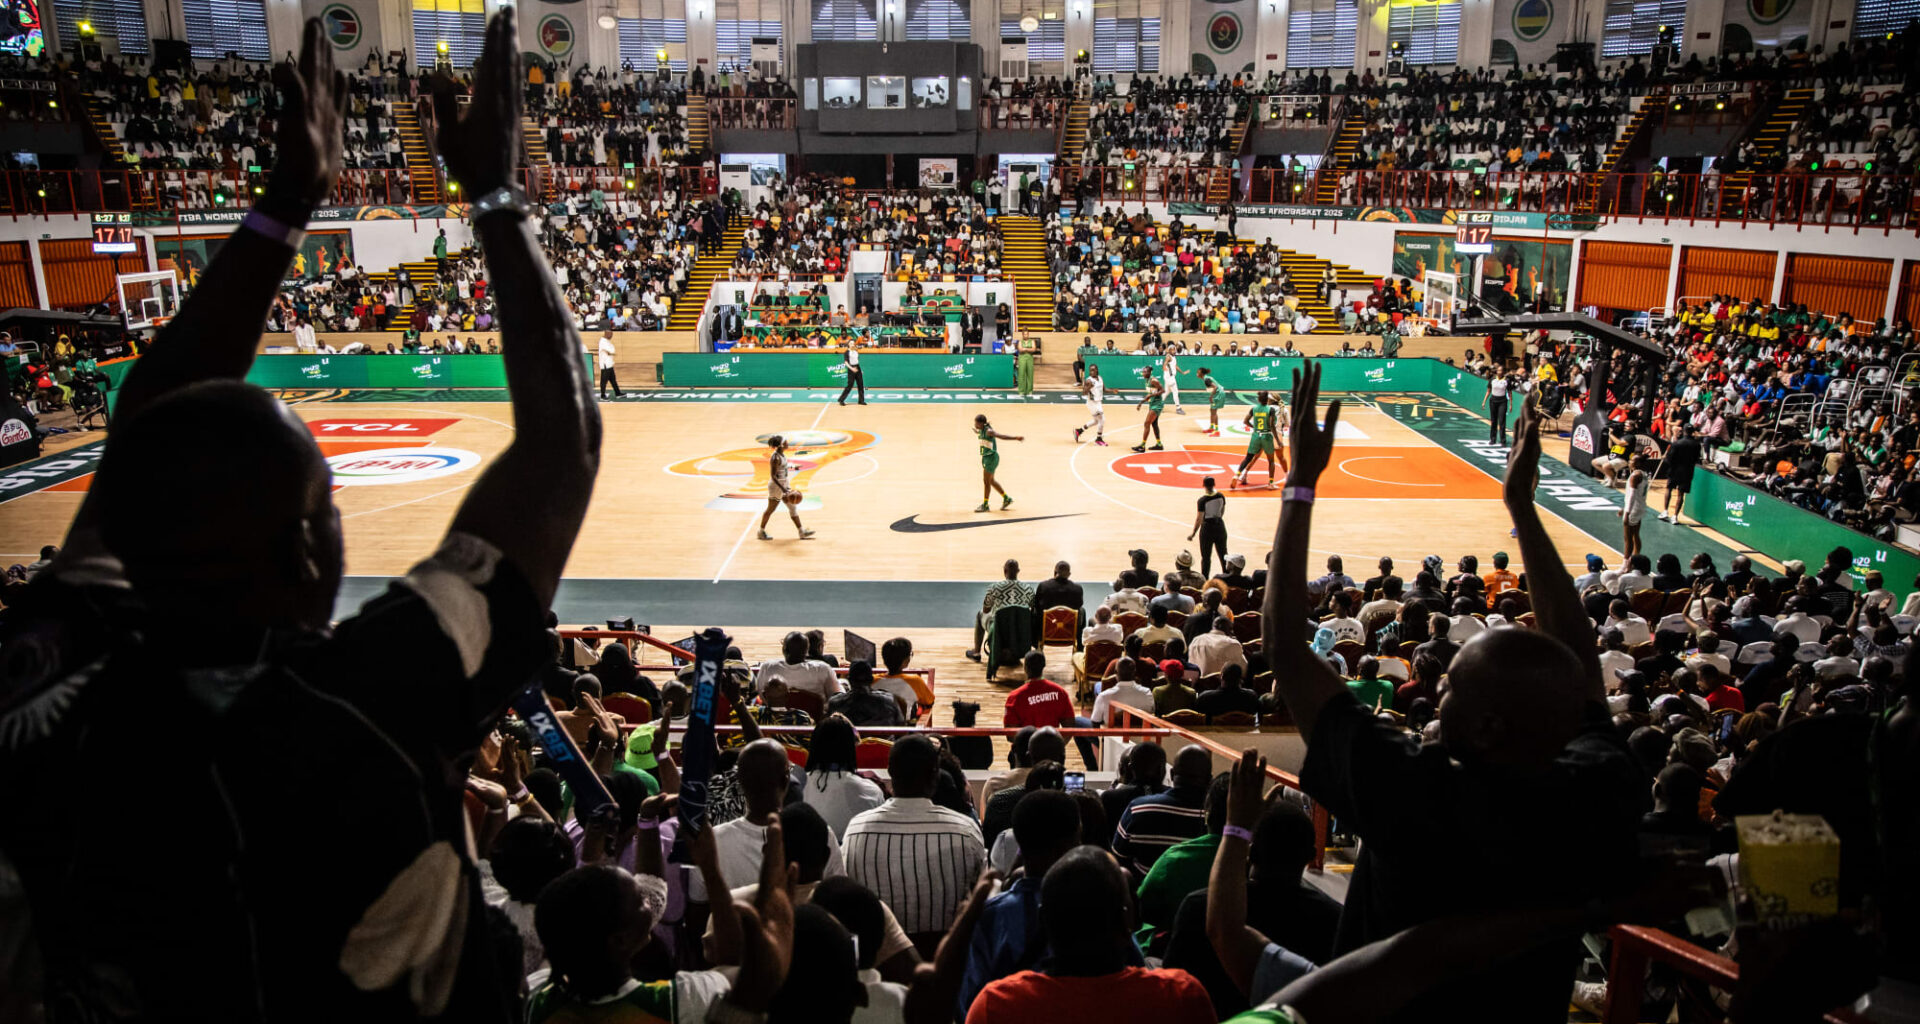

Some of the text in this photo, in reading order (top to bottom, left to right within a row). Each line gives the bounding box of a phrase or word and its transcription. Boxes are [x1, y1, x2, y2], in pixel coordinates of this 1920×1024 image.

[203, 212, 249, 221] WOMEN'
[318, 210, 340, 218] 2025
[1236, 206, 1266, 214] OMEN'S
[1268, 207, 1321, 216] AFROBASKET
[1323, 209, 1343, 217] 2025
[95, 214, 114, 223] 6:27
[1471, 213, 1492, 223] 6:27
[1493, 214, 1528, 225] BIDJAN
[95, 227, 115, 243] 17
[119, 227, 132, 243] 17
[1469, 228, 1490, 244] 17
[625, 390, 793, 399] WOMEN'S
[320, 423, 420, 431] TCL
[1257, 417, 1265, 430] 2
[1125, 463, 1270, 475] TCL
[1747, 494, 1757, 506] U
[1875, 549, 1888, 563] U
[1027, 691, 1059, 705] SECURITY
